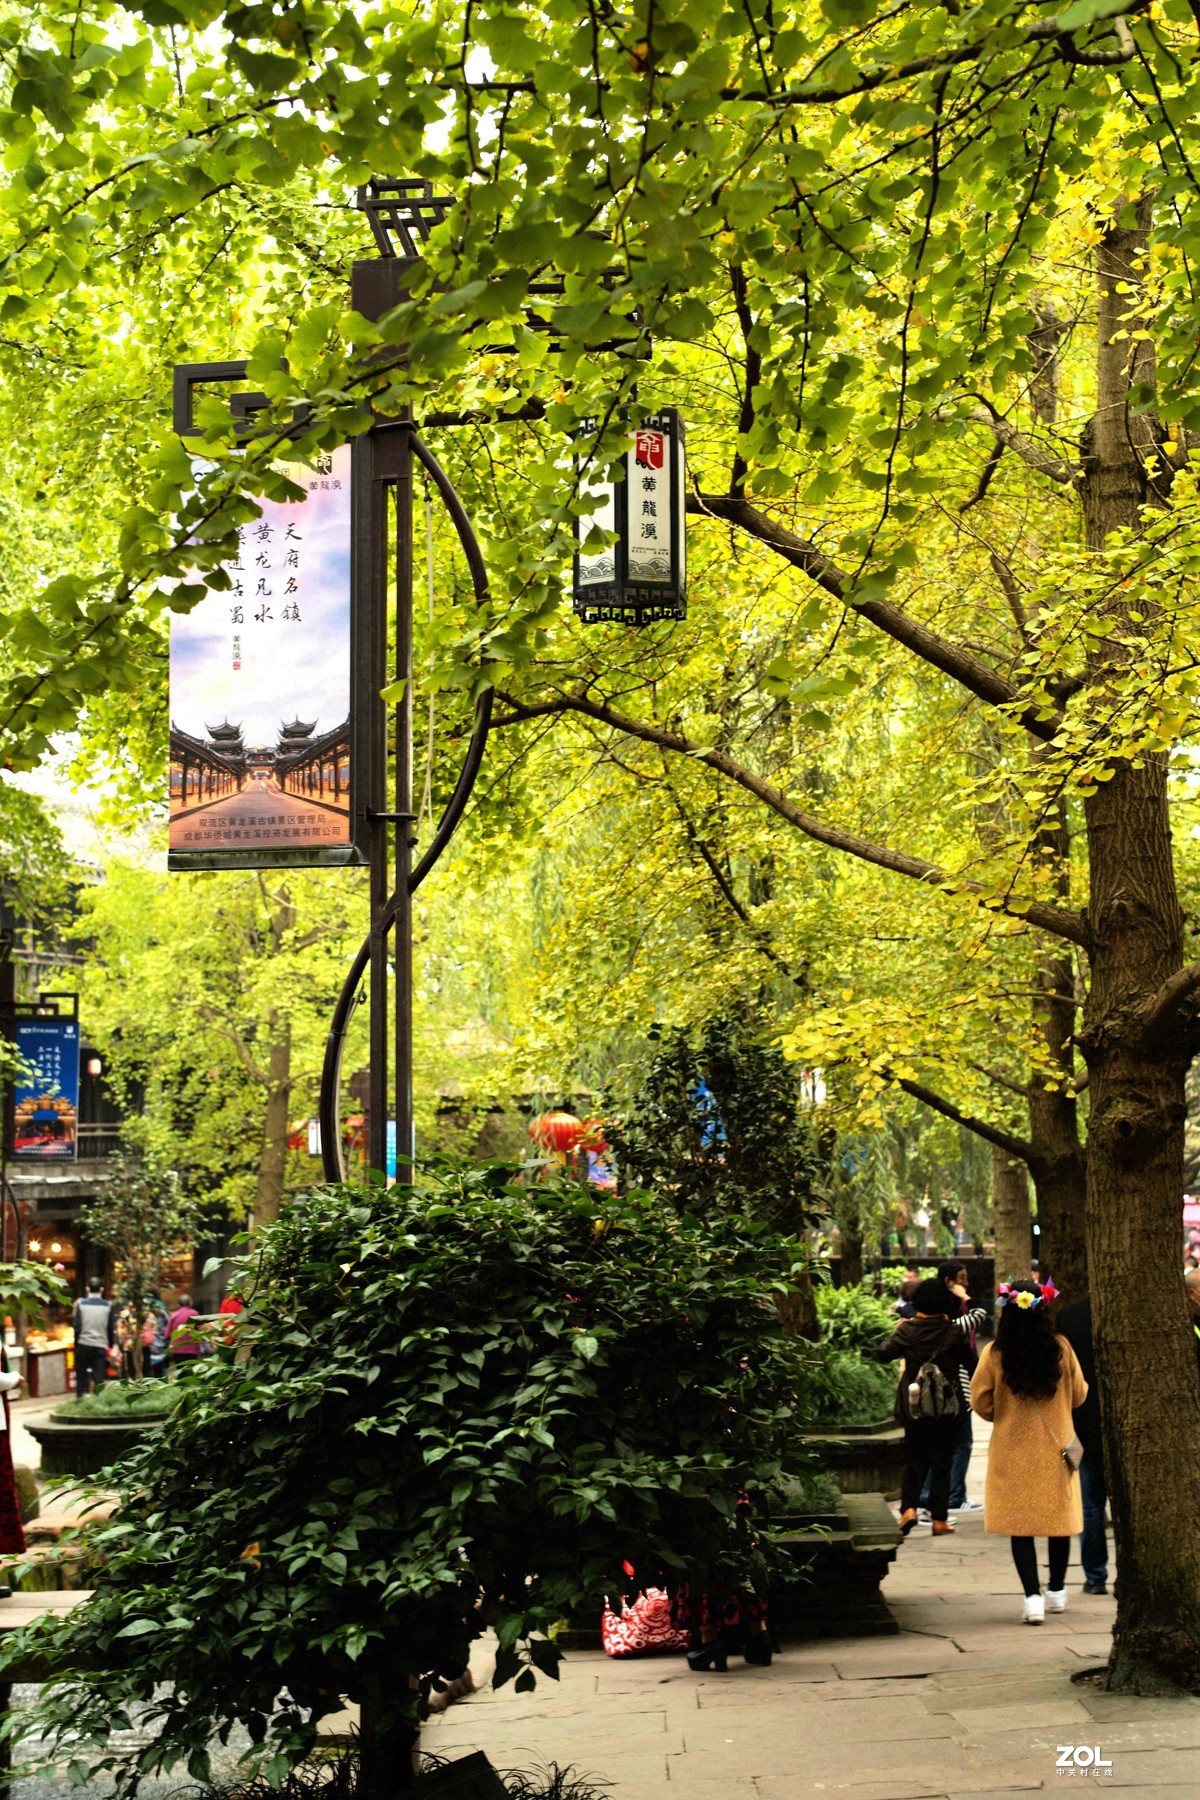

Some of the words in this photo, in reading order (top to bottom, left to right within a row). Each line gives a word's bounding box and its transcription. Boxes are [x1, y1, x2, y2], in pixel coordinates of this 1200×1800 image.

[280, 522, 303, 623] 天府名镇
[198, 814, 327, 828] 双流区黄龙溪古镇景区管理局
